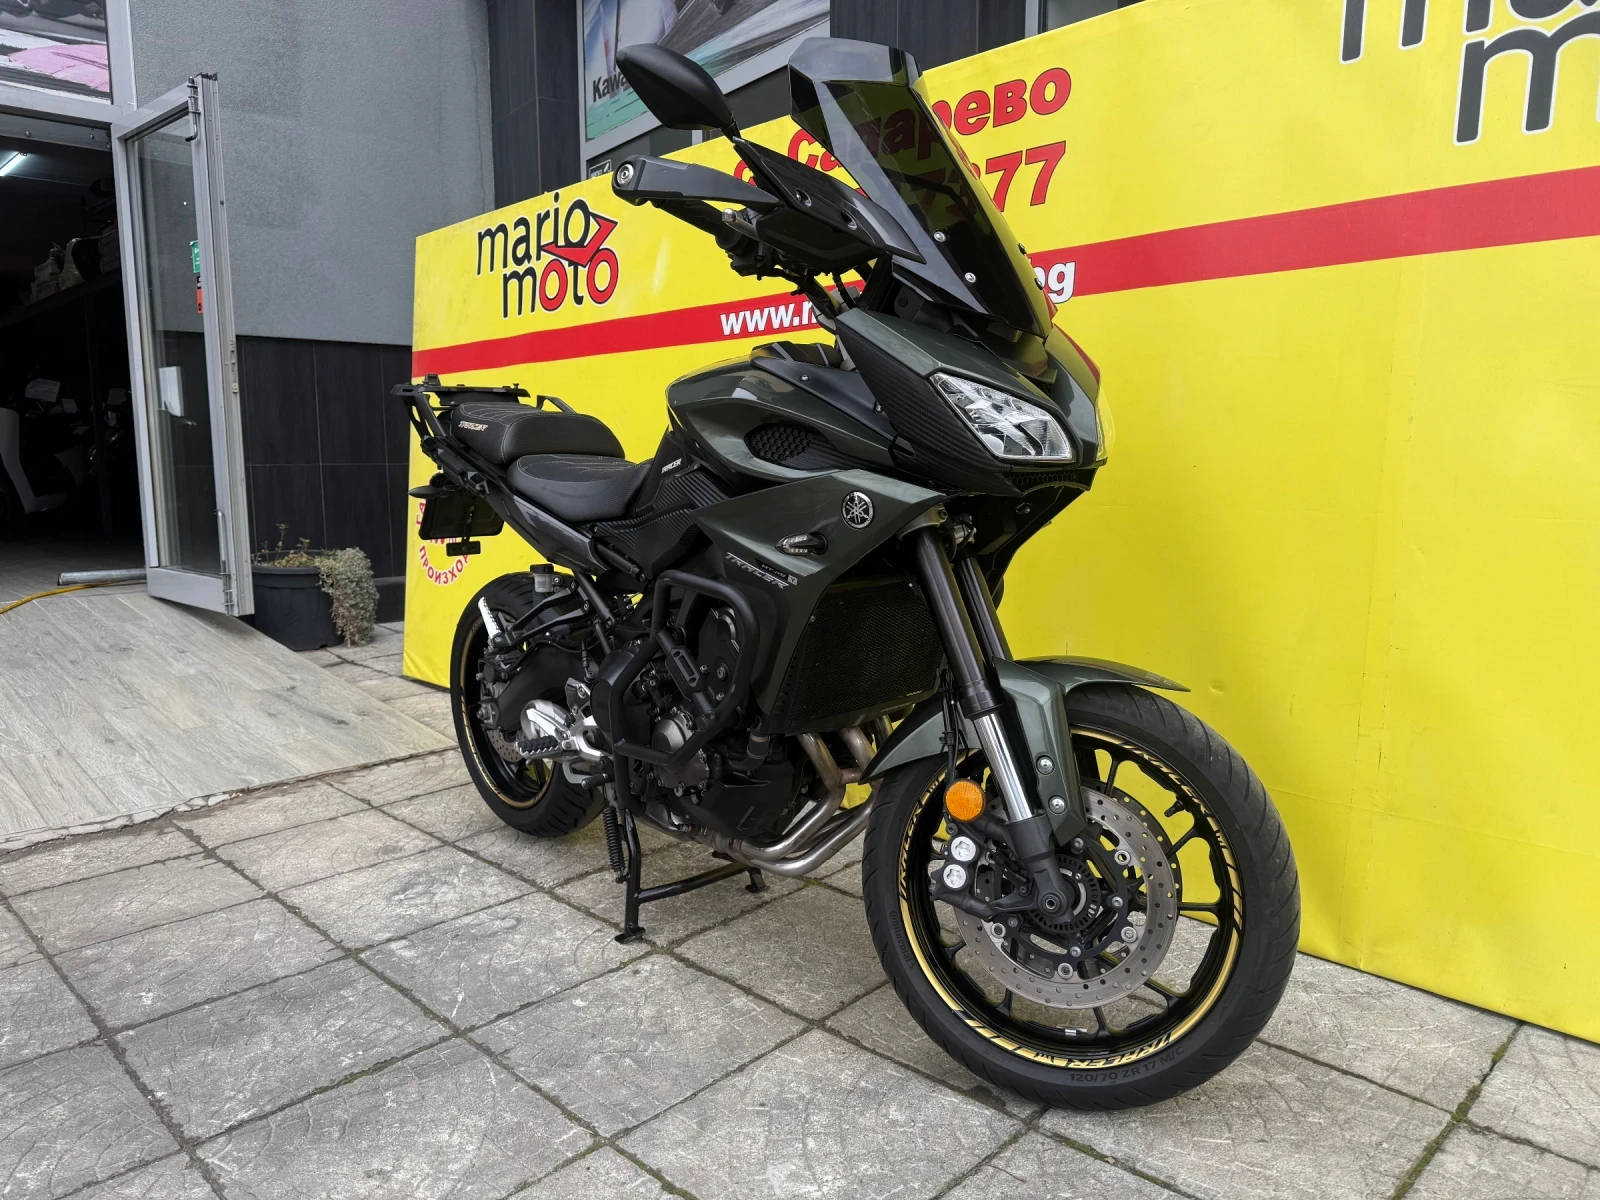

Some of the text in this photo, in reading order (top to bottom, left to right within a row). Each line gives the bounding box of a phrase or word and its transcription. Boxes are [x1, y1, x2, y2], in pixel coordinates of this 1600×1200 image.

[477, 192, 590, 275] mario
[502, 247, 619, 318] moto
[725, 551, 790, 589] TRACER
[1069, 1071, 1118, 1083] 120/70
[1122, 1066, 1141, 1079] ZR
[1142, 1060, 1157, 1073] 17
